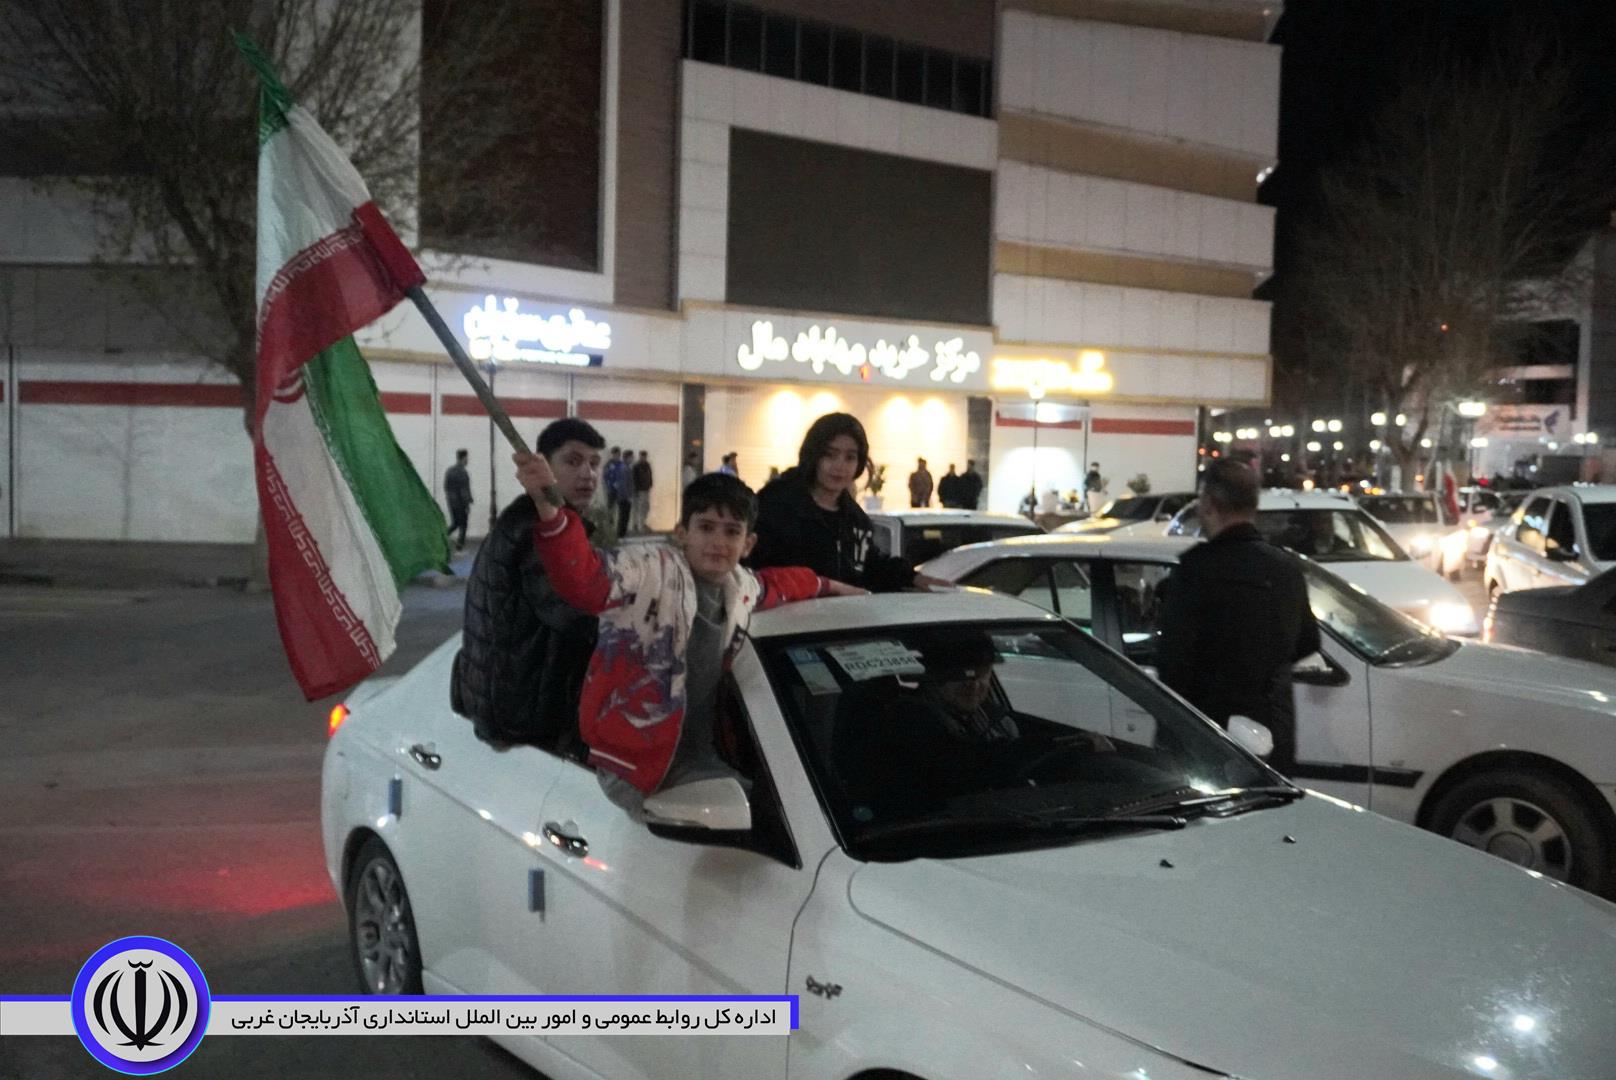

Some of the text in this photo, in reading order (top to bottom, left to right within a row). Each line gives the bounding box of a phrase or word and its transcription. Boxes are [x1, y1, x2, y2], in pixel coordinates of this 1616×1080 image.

[738, 321, 789, 370] مال
[792, 325, 867, 375] مهاباد
[869, 334, 929, 380] خرید
[930, 337, 980, 383] مرکز
